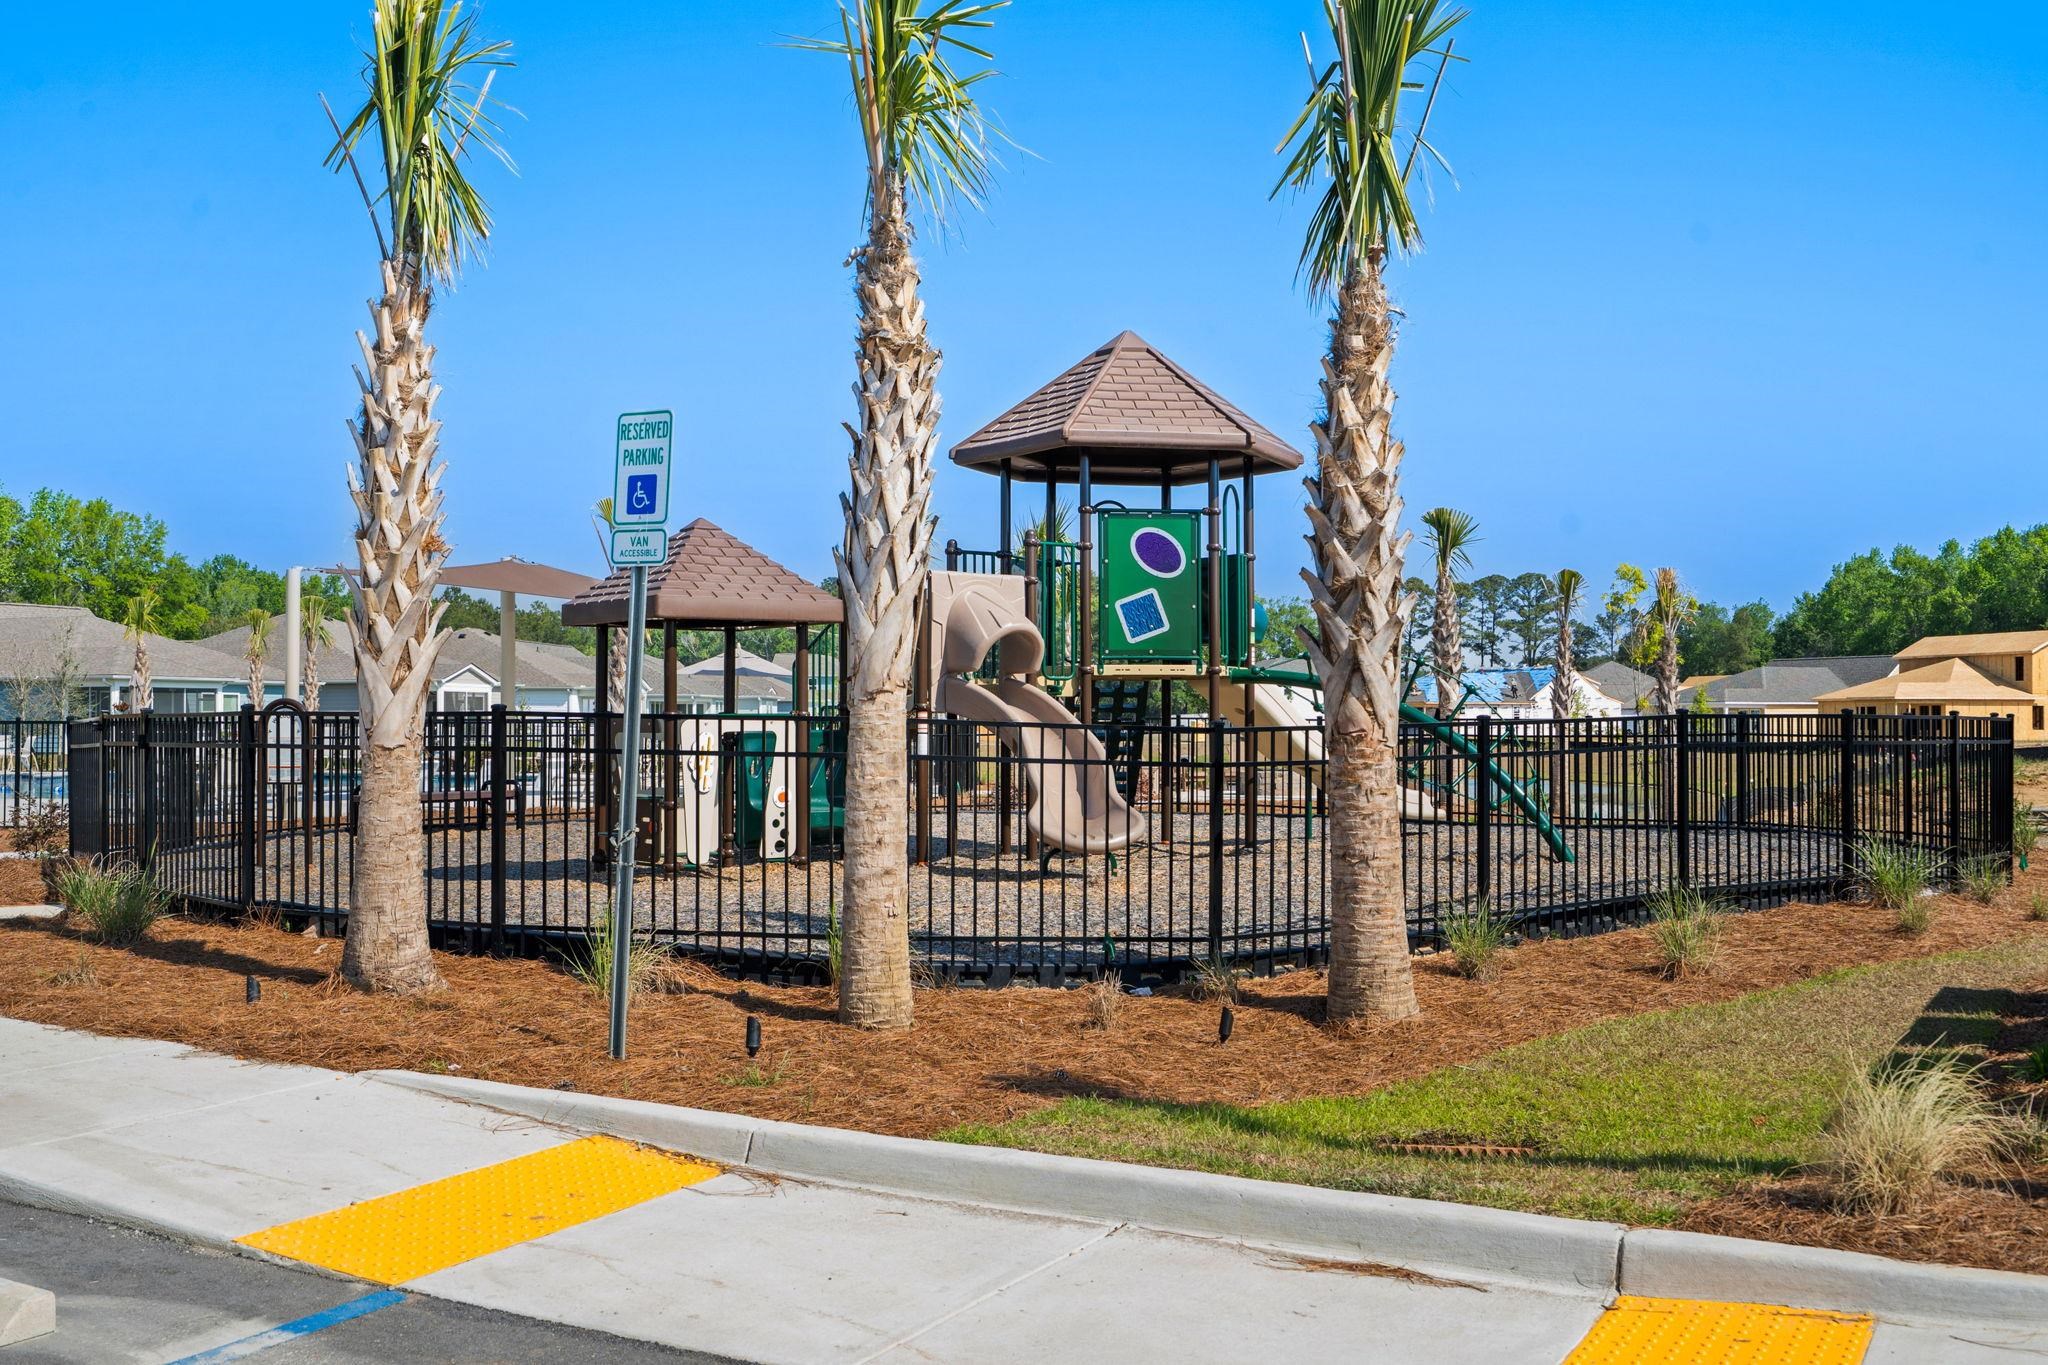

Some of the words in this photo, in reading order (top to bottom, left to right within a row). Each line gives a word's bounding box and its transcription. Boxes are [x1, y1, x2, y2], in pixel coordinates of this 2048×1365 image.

[621, 421, 668, 440] RESERVED
[623, 447, 664, 466] PARKING
[630, 536, 648, 547] VAN
[619, 549, 657, 557] ACCESSIBLE
